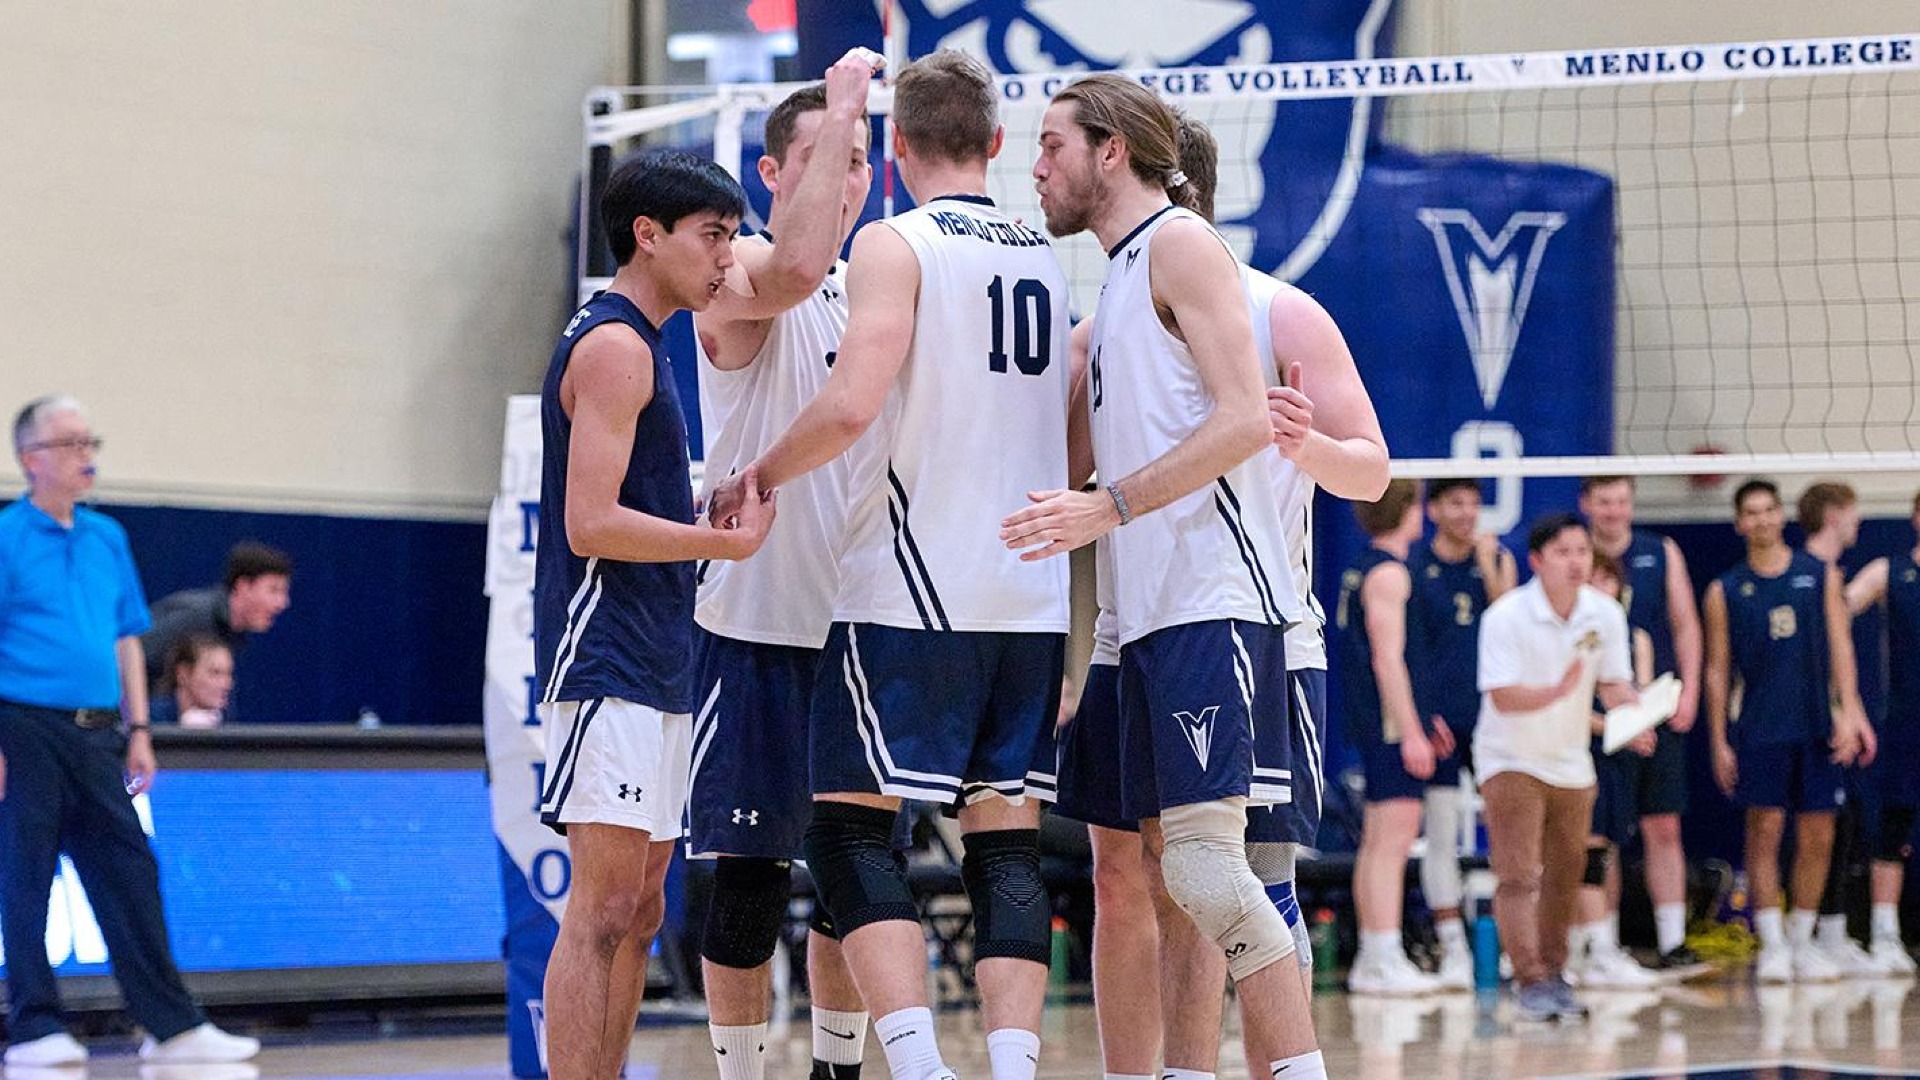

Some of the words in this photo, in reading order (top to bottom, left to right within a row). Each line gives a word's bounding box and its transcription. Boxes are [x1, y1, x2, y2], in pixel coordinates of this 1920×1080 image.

[1565, 50, 1705, 76] MENLO
[1723, 39, 1912, 70] COLLEGE
[1227, 61, 1473, 91] VOLLEYBALL
[986, 221, 1050, 247] COLLE
[987, 274, 1052, 375] 10
